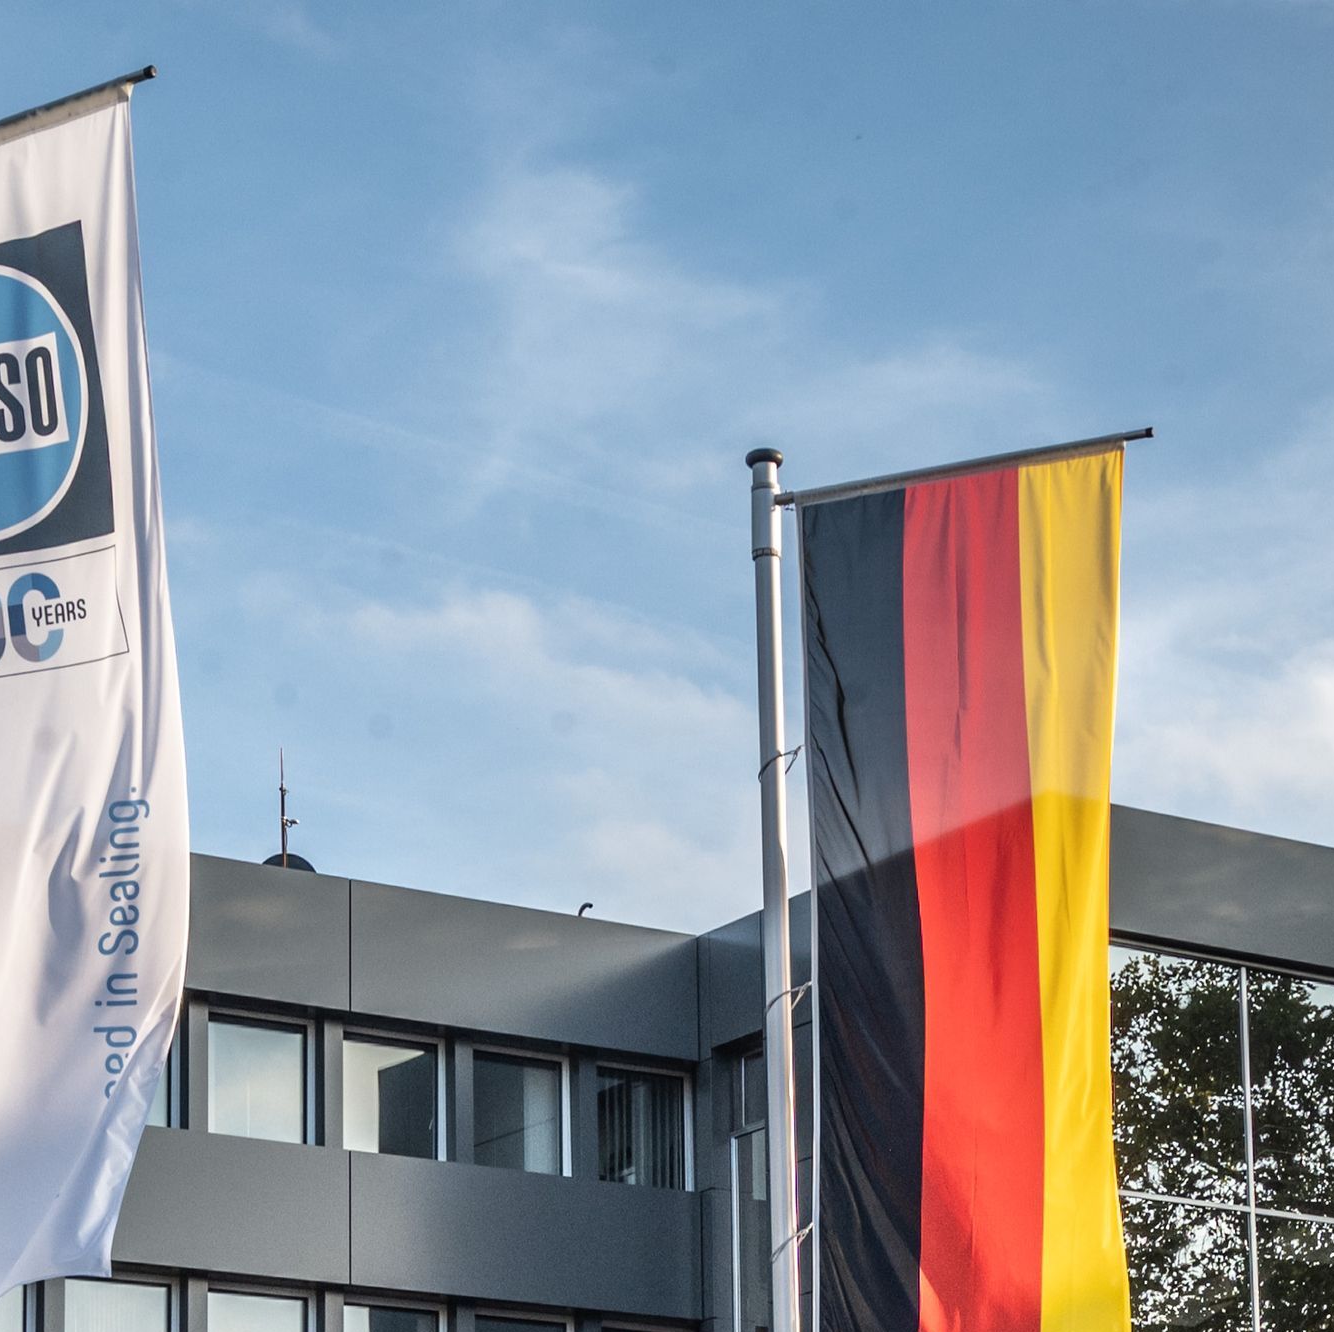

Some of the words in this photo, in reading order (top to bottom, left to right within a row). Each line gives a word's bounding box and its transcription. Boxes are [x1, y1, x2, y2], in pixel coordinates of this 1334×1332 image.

[31, 597, 88, 628] YEARS
[97, 785, 151, 956] Sealing.
[94, 972, 139, 1007] in
